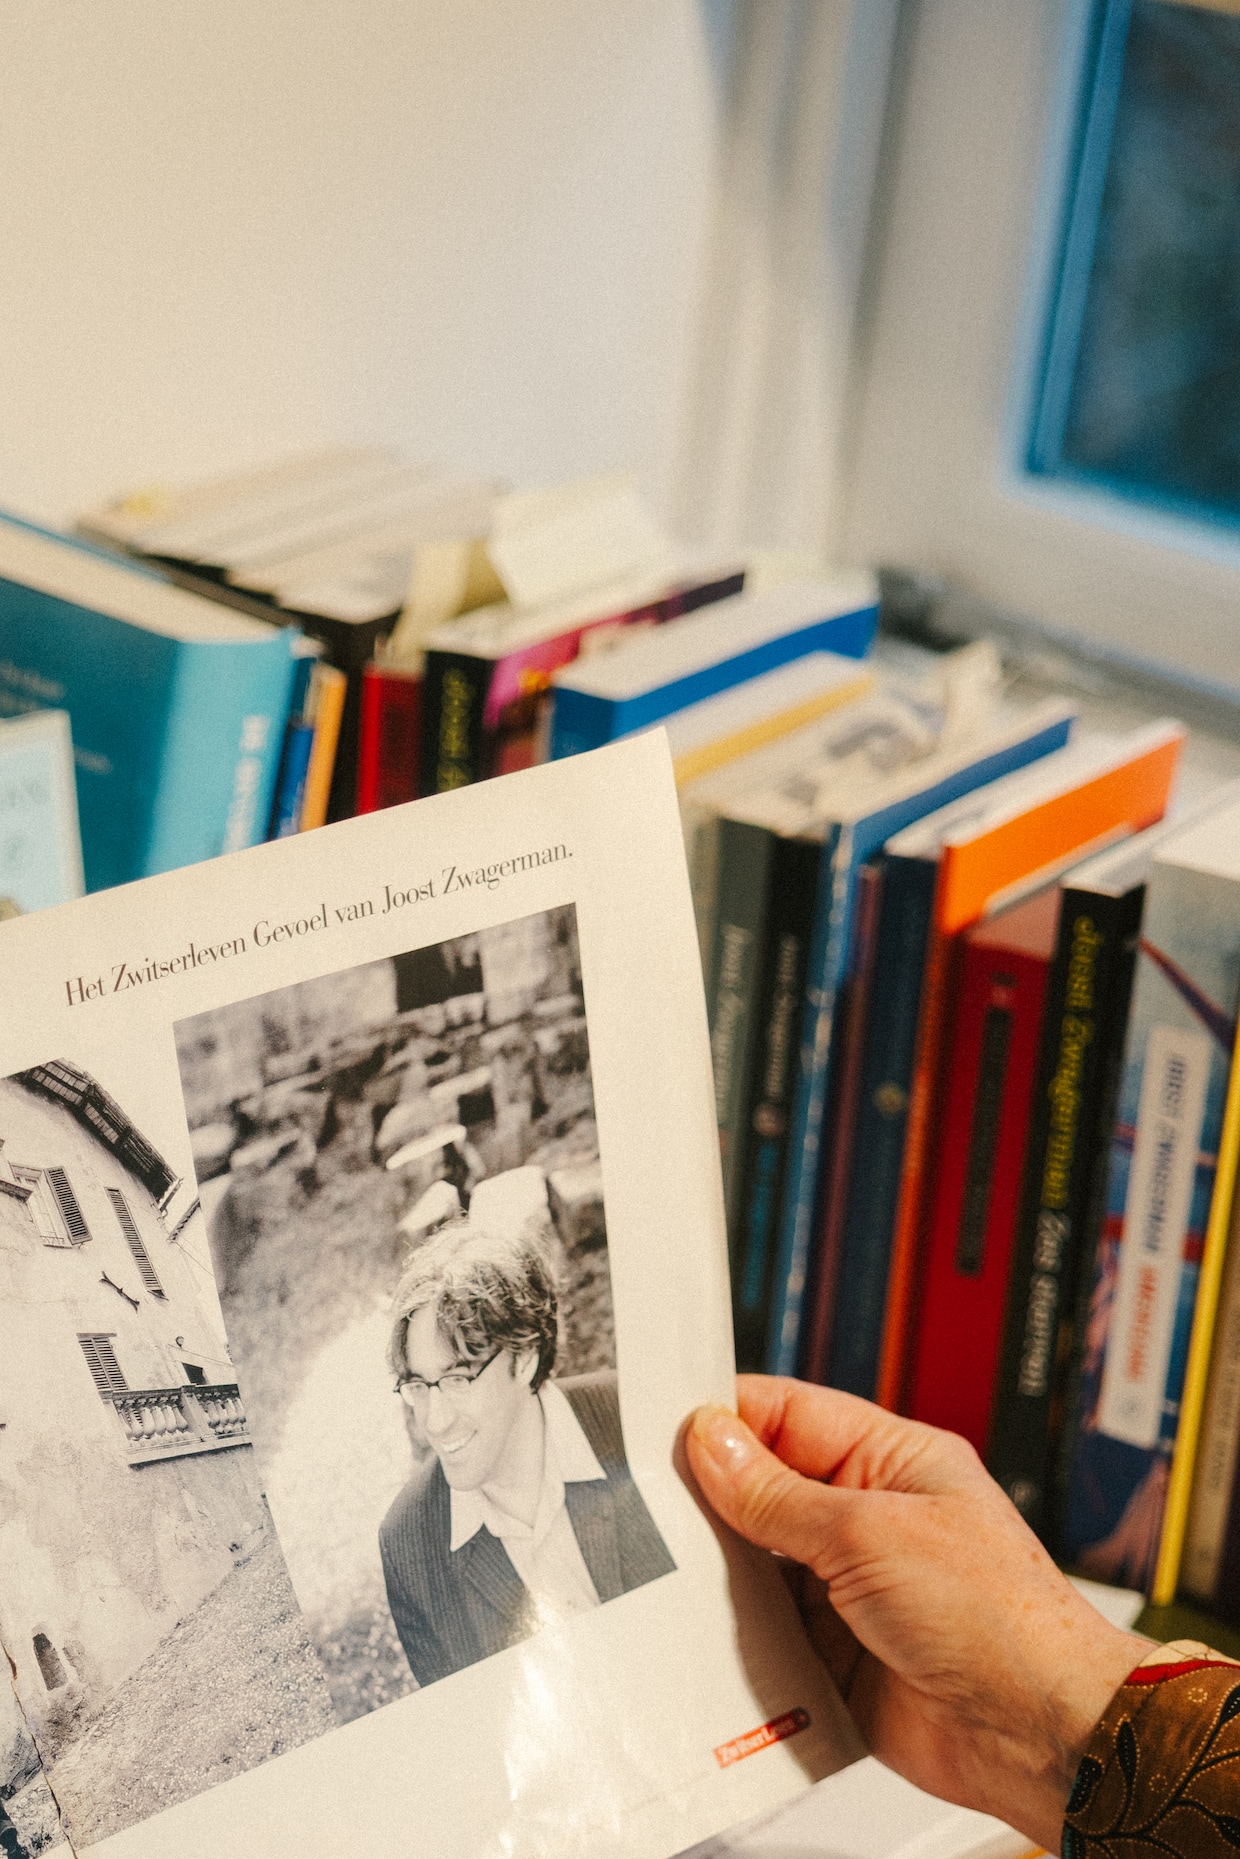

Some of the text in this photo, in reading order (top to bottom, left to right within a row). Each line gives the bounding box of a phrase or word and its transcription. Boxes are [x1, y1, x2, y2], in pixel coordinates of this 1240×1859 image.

[65, 843, 575, 1007] Het Zwitserleven Gevoel van Joost Zwagerman.
